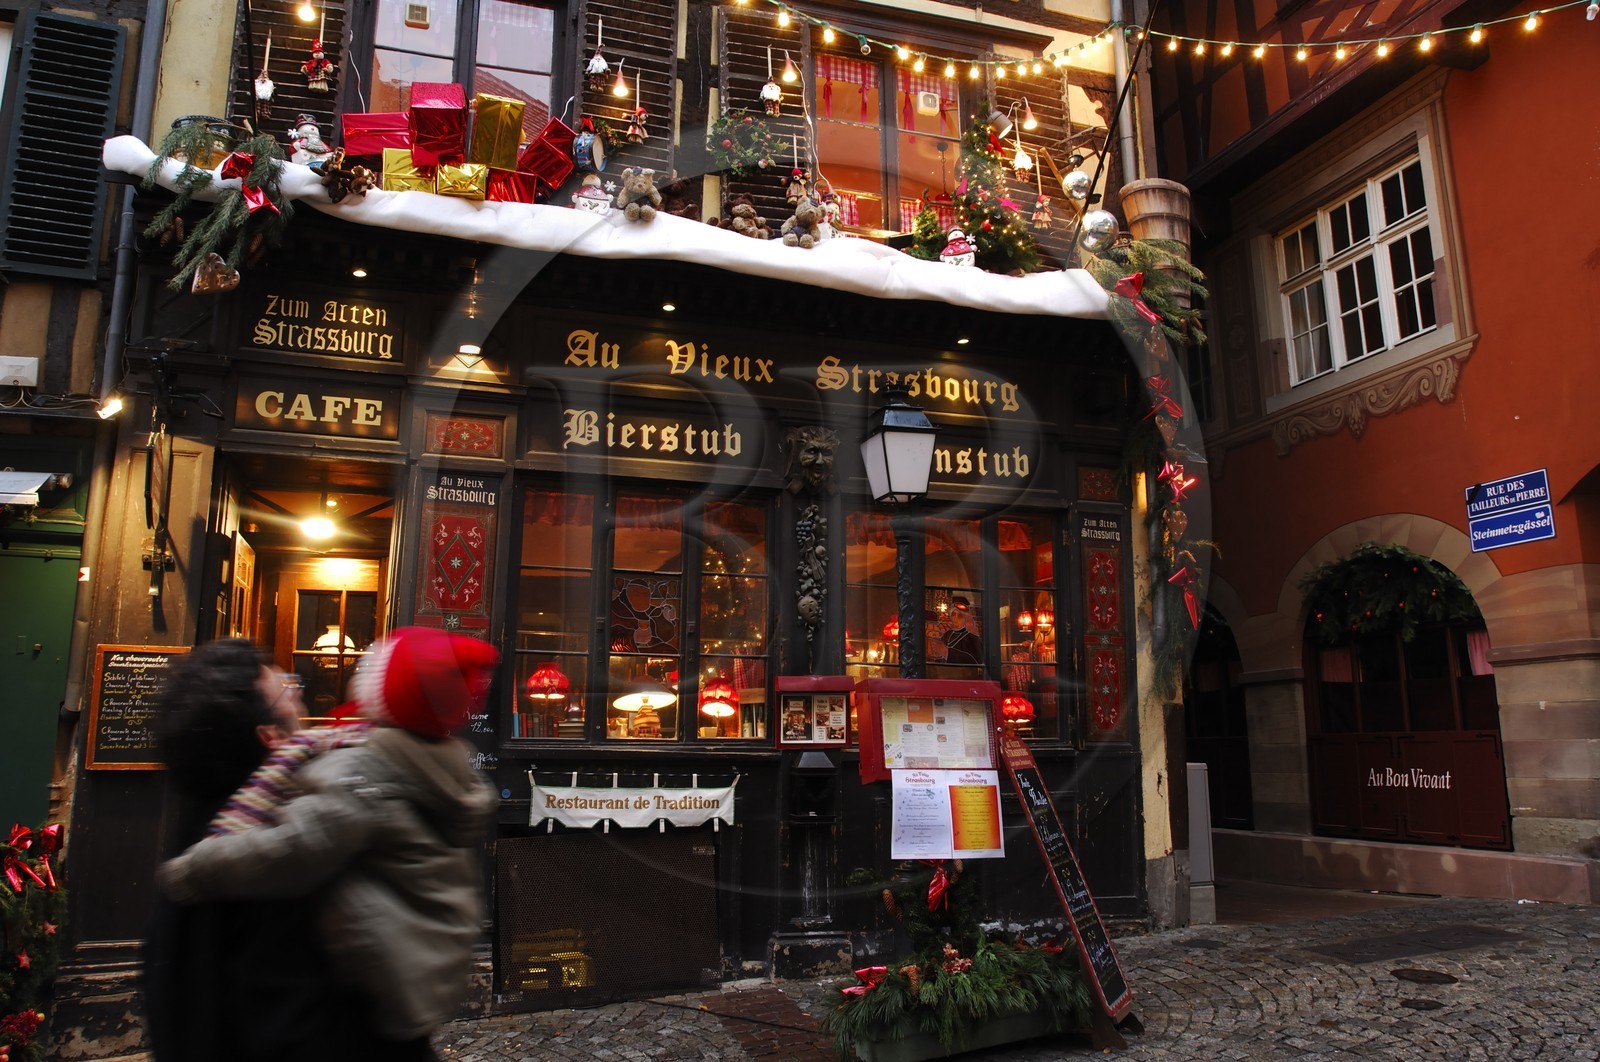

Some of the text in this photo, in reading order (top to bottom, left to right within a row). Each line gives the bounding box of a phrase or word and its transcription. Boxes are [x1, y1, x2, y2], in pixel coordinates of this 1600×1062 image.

[266, 295, 387, 326] Zum Alten
[253, 319, 393, 359] Strassburg
[565, 329, 620, 370] Au
[665, 340, 774, 383] Vieux
[255, 391, 383, 426] CAFE
[564, 409, 742, 457] Bierstub
[441, 477, 484, 488] Au Vieux
[1487, 480, 1525, 498] RUE DES
[427, 486, 496, 506] Strasbourg
[1471, 495, 1510, 512] TAILLEURS
[1516, 487, 1546, 502] PIERRE
[1081, 528, 1120, 541] Strassburg
[1084, 518, 1117, 529] Zum Alten
[1473, 516, 1551, 541] Steinmetzgässel
[1368, 768, 1452, 789] Au Bon Vivant
[545, 794, 720, 810] Restaurant de Tradition
